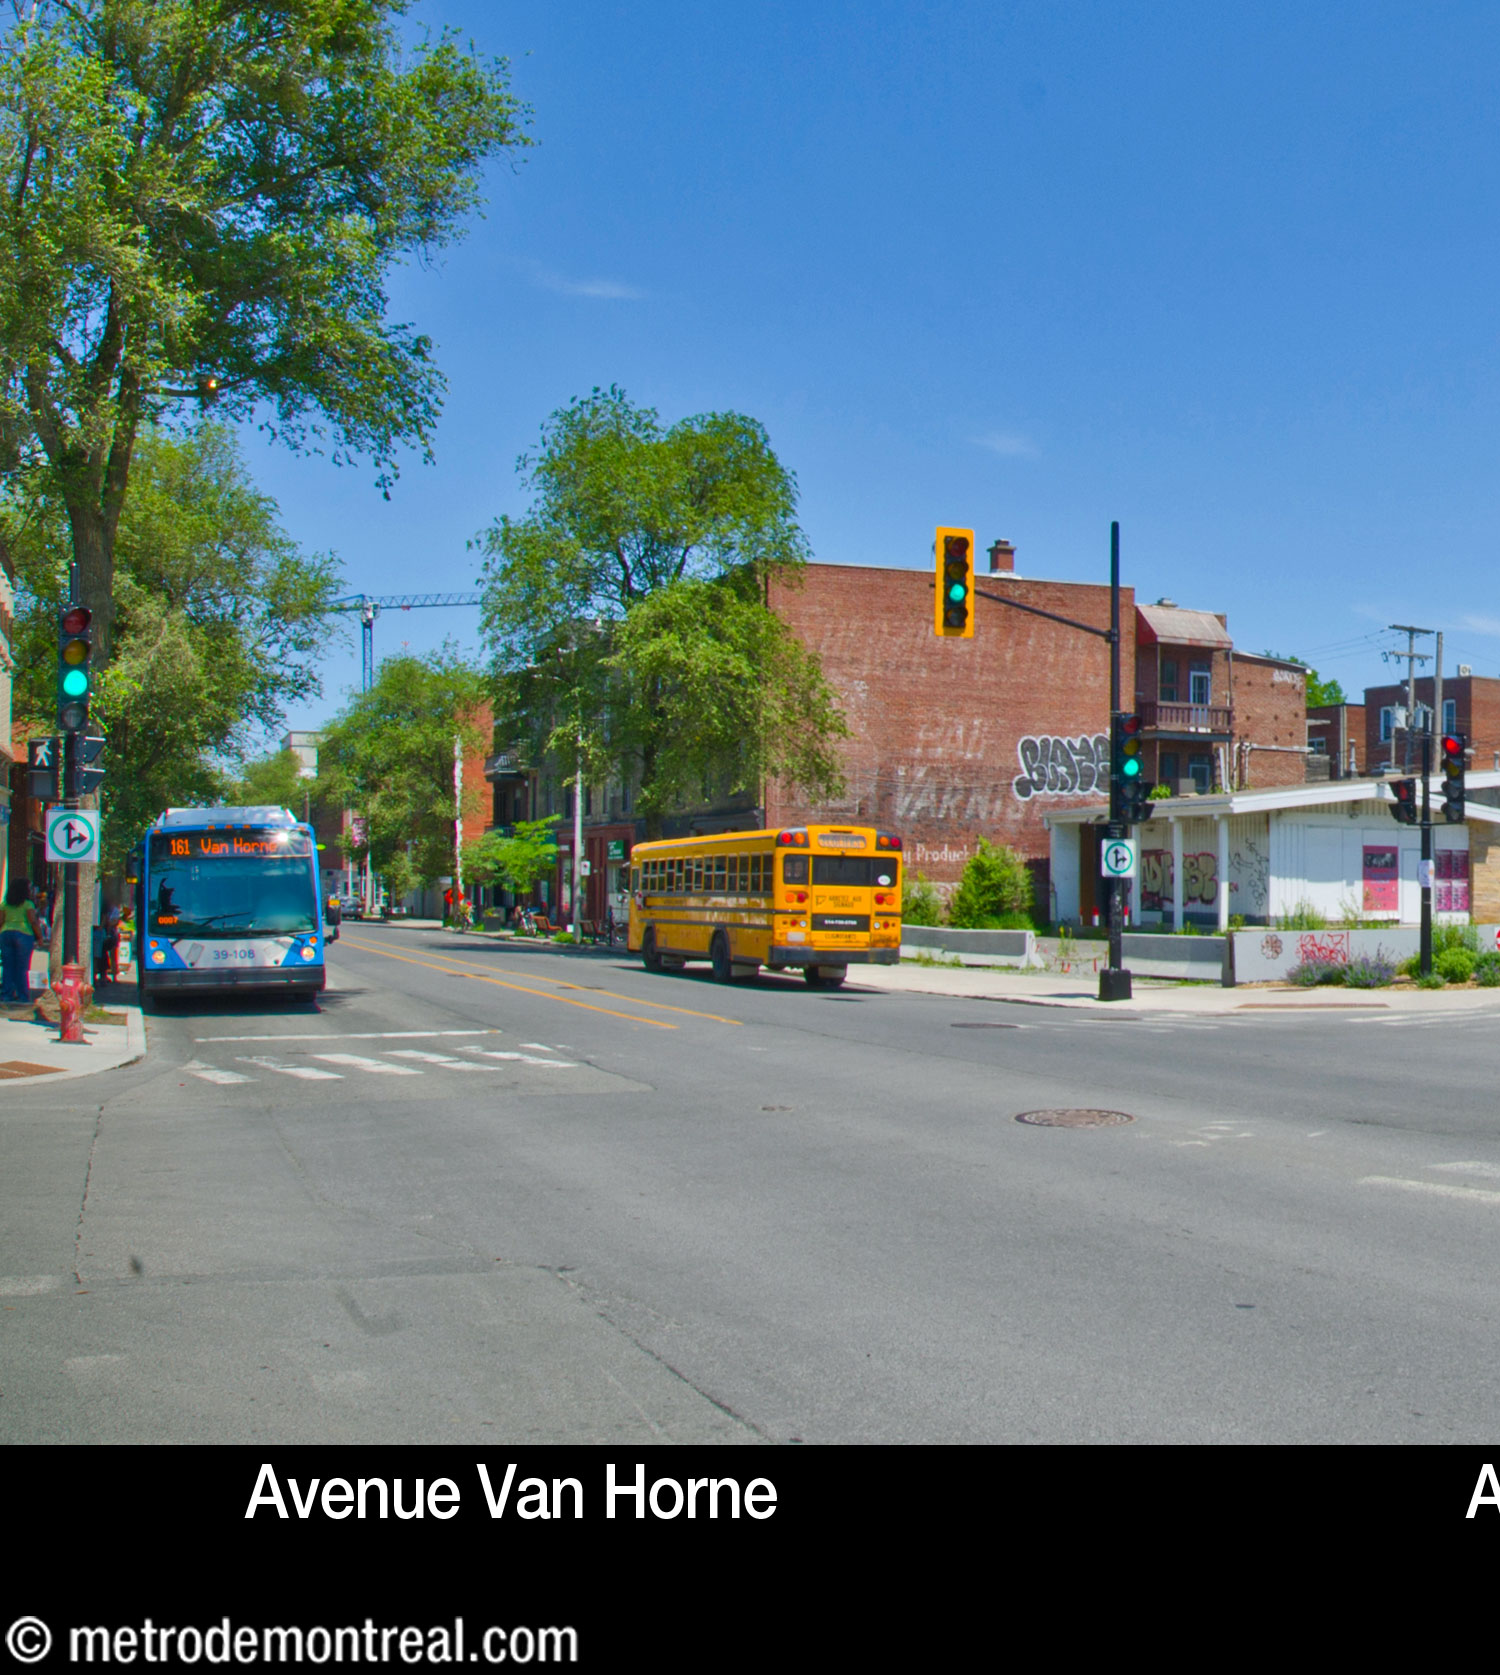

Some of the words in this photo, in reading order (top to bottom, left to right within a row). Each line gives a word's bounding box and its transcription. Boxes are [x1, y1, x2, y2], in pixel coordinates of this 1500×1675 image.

[170, 839, 190, 855] 161
[201, 838, 229, 854] Van
[233, 837, 277, 854] Horne
[915, 843, 968, 863] Product
[213, 949, 256, 960] 39-108
